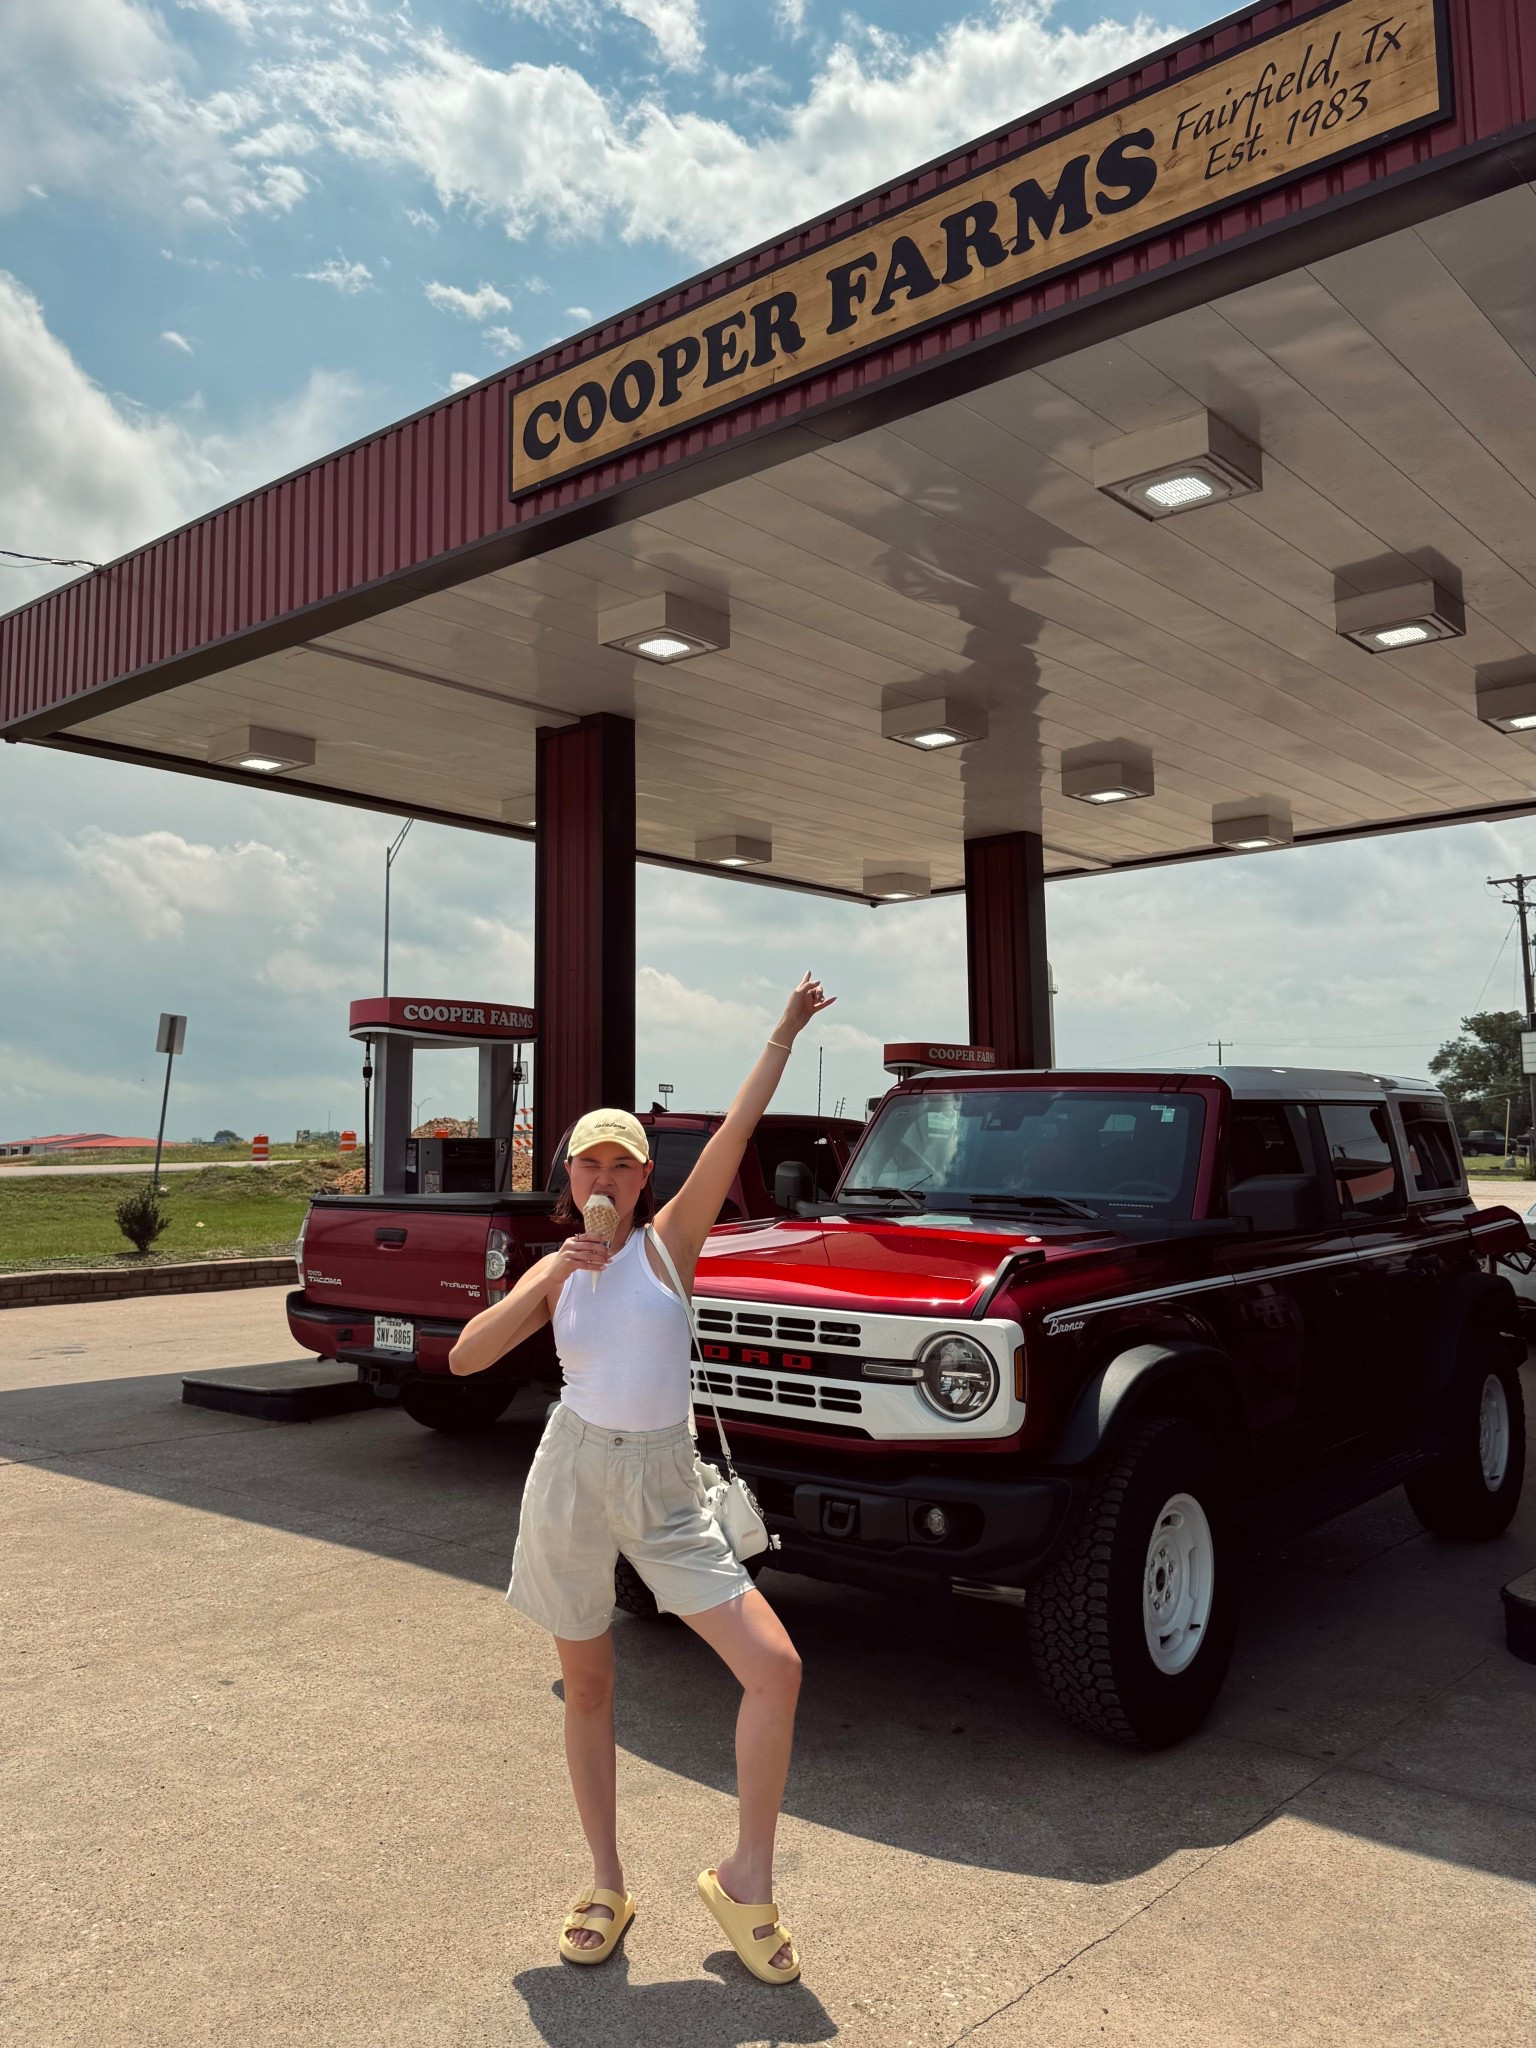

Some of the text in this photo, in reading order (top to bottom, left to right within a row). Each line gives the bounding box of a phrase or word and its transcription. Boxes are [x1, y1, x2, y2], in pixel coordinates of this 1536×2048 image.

[1172, 31, 1340, 150] Fairfield,
[1204, 79, 1371, 180] Est. 1983
[522, 127, 1158, 461] COOPER FARMS
[403, 1005, 534, 1029] COOPER FARMS
[928, 1048, 975, 1061] COOPER
[500, 1142, 506, 1154] 5
[524, 1241, 563, 1257] TR
[308, 1276, 343, 1286] TACOMA
[440, 1280, 480, 1290] PreRunner
[468, 1290, 481, 1298] V6
[1046, 1318, 1086, 1336] Bronco
[703, 1344, 812, 1370] ORD
